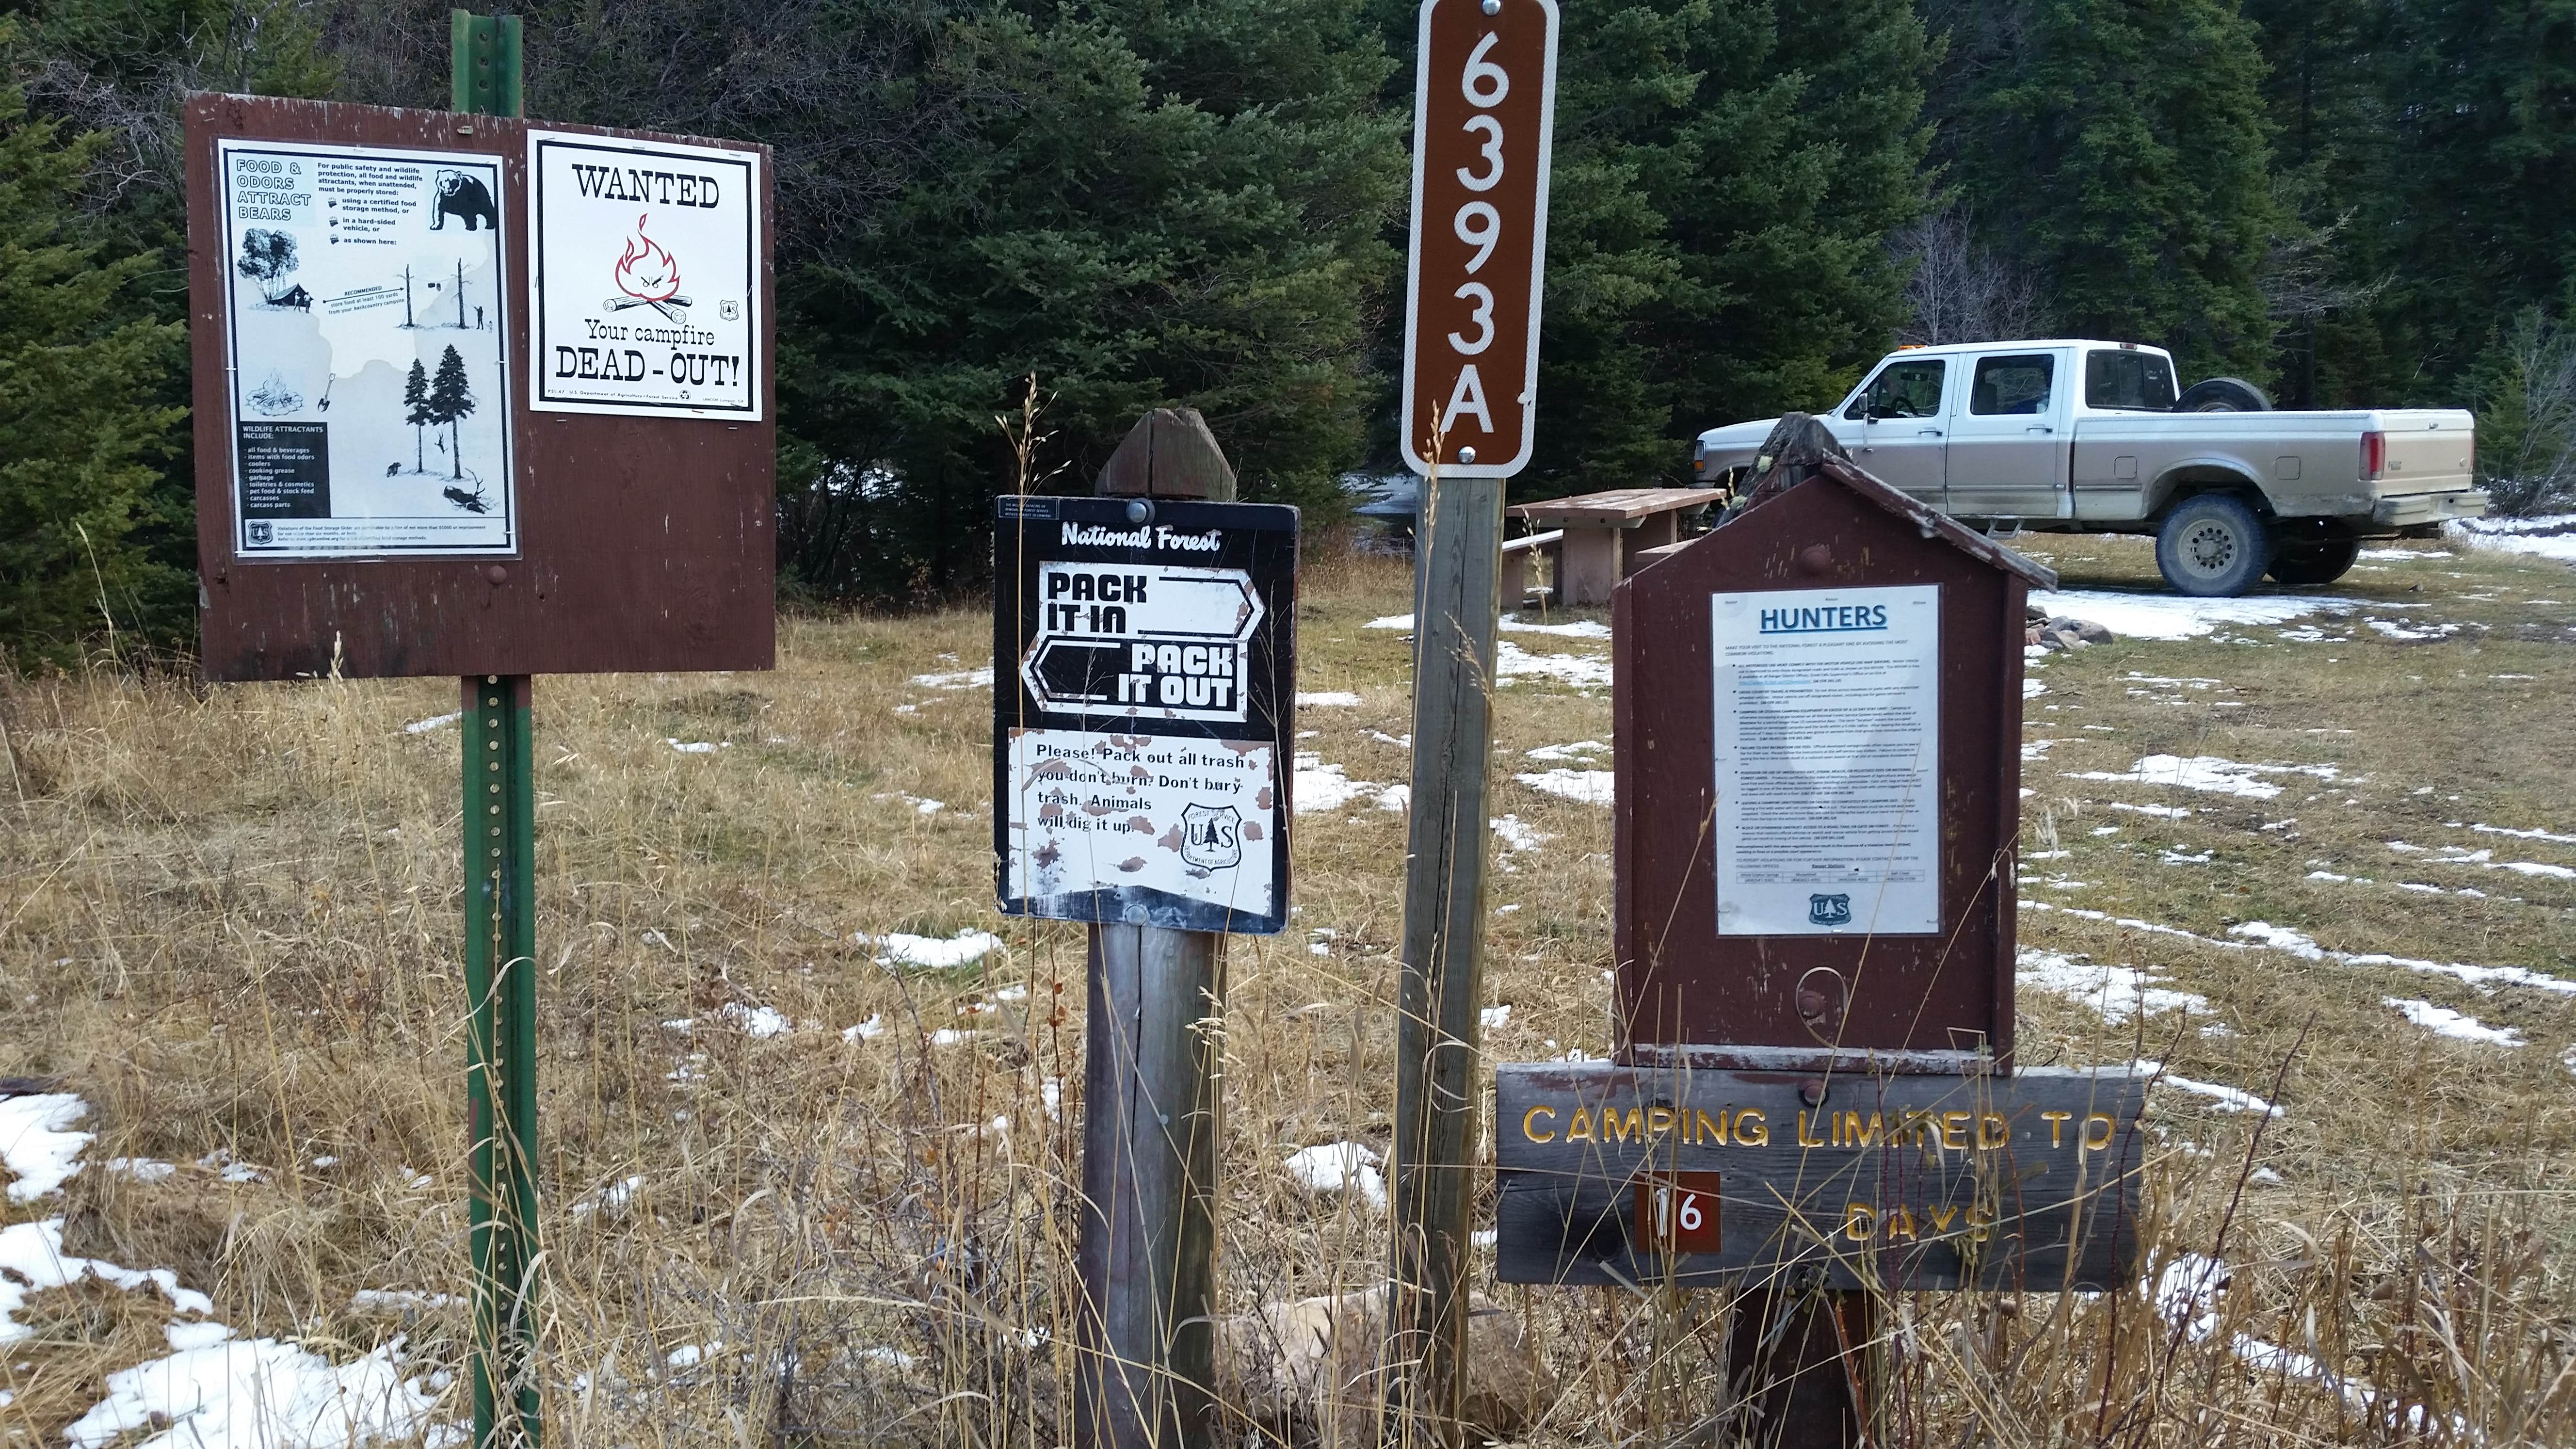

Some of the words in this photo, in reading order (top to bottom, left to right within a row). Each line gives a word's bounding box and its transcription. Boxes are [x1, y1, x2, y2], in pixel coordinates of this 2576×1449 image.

[236, 159, 282, 173] FOOD
[290, 162, 302, 175] &
[237, 175, 294, 190] ODORS
[572, 163, 719, 209] WANTED
[238, 191, 311, 206] ATTRACT
[239, 207, 291, 221] BEARS
[344, 286, 382, 296] RECOMMENDED
[585, 319, 628, 340] Your
[635, 324, 714, 350] campfire
[1062, 521, 1151, 548] National
[1155, 524, 1222, 551] Forest
[1048, 572, 1147, 603] PACK
[1047, 603, 1080, 631] IT
[1090, 605, 1126, 633] IN
[1761, 605, 1887, 629] HUNTERS
[1131, 643, 1233, 676] PACK
[1118, 673, 1152, 703] IT
[1160, 676, 1233, 707] OUT
[1037, 744, 1095, 759] Please!
[1103, 748, 1141, 762] Pack
[1147, 752, 1173, 764] out
[1179, 753, 1196, 765] all
[1201, 754, 1244, 768] trash
[1038, 772, 1063, 782] you
[1069, 770, 1106, 783] don't
[1159, 775, 1198, 789] Don't
[1205, 777, 1240, 794] bury
[1037, 791, 1082, 805] trash.
[1091, 795, 1151, 810] Animals
[1069, 817, 1091, 832] dig
[1097, 818, 1108, 830] it
[1188, 811, 1209, 821] FOREST
[1523, 1105, 1769, 1147] CAMPING
[2041, 1111, 2116, 1151] TO
[1847, 1202, 1993, 1242] DAYS
